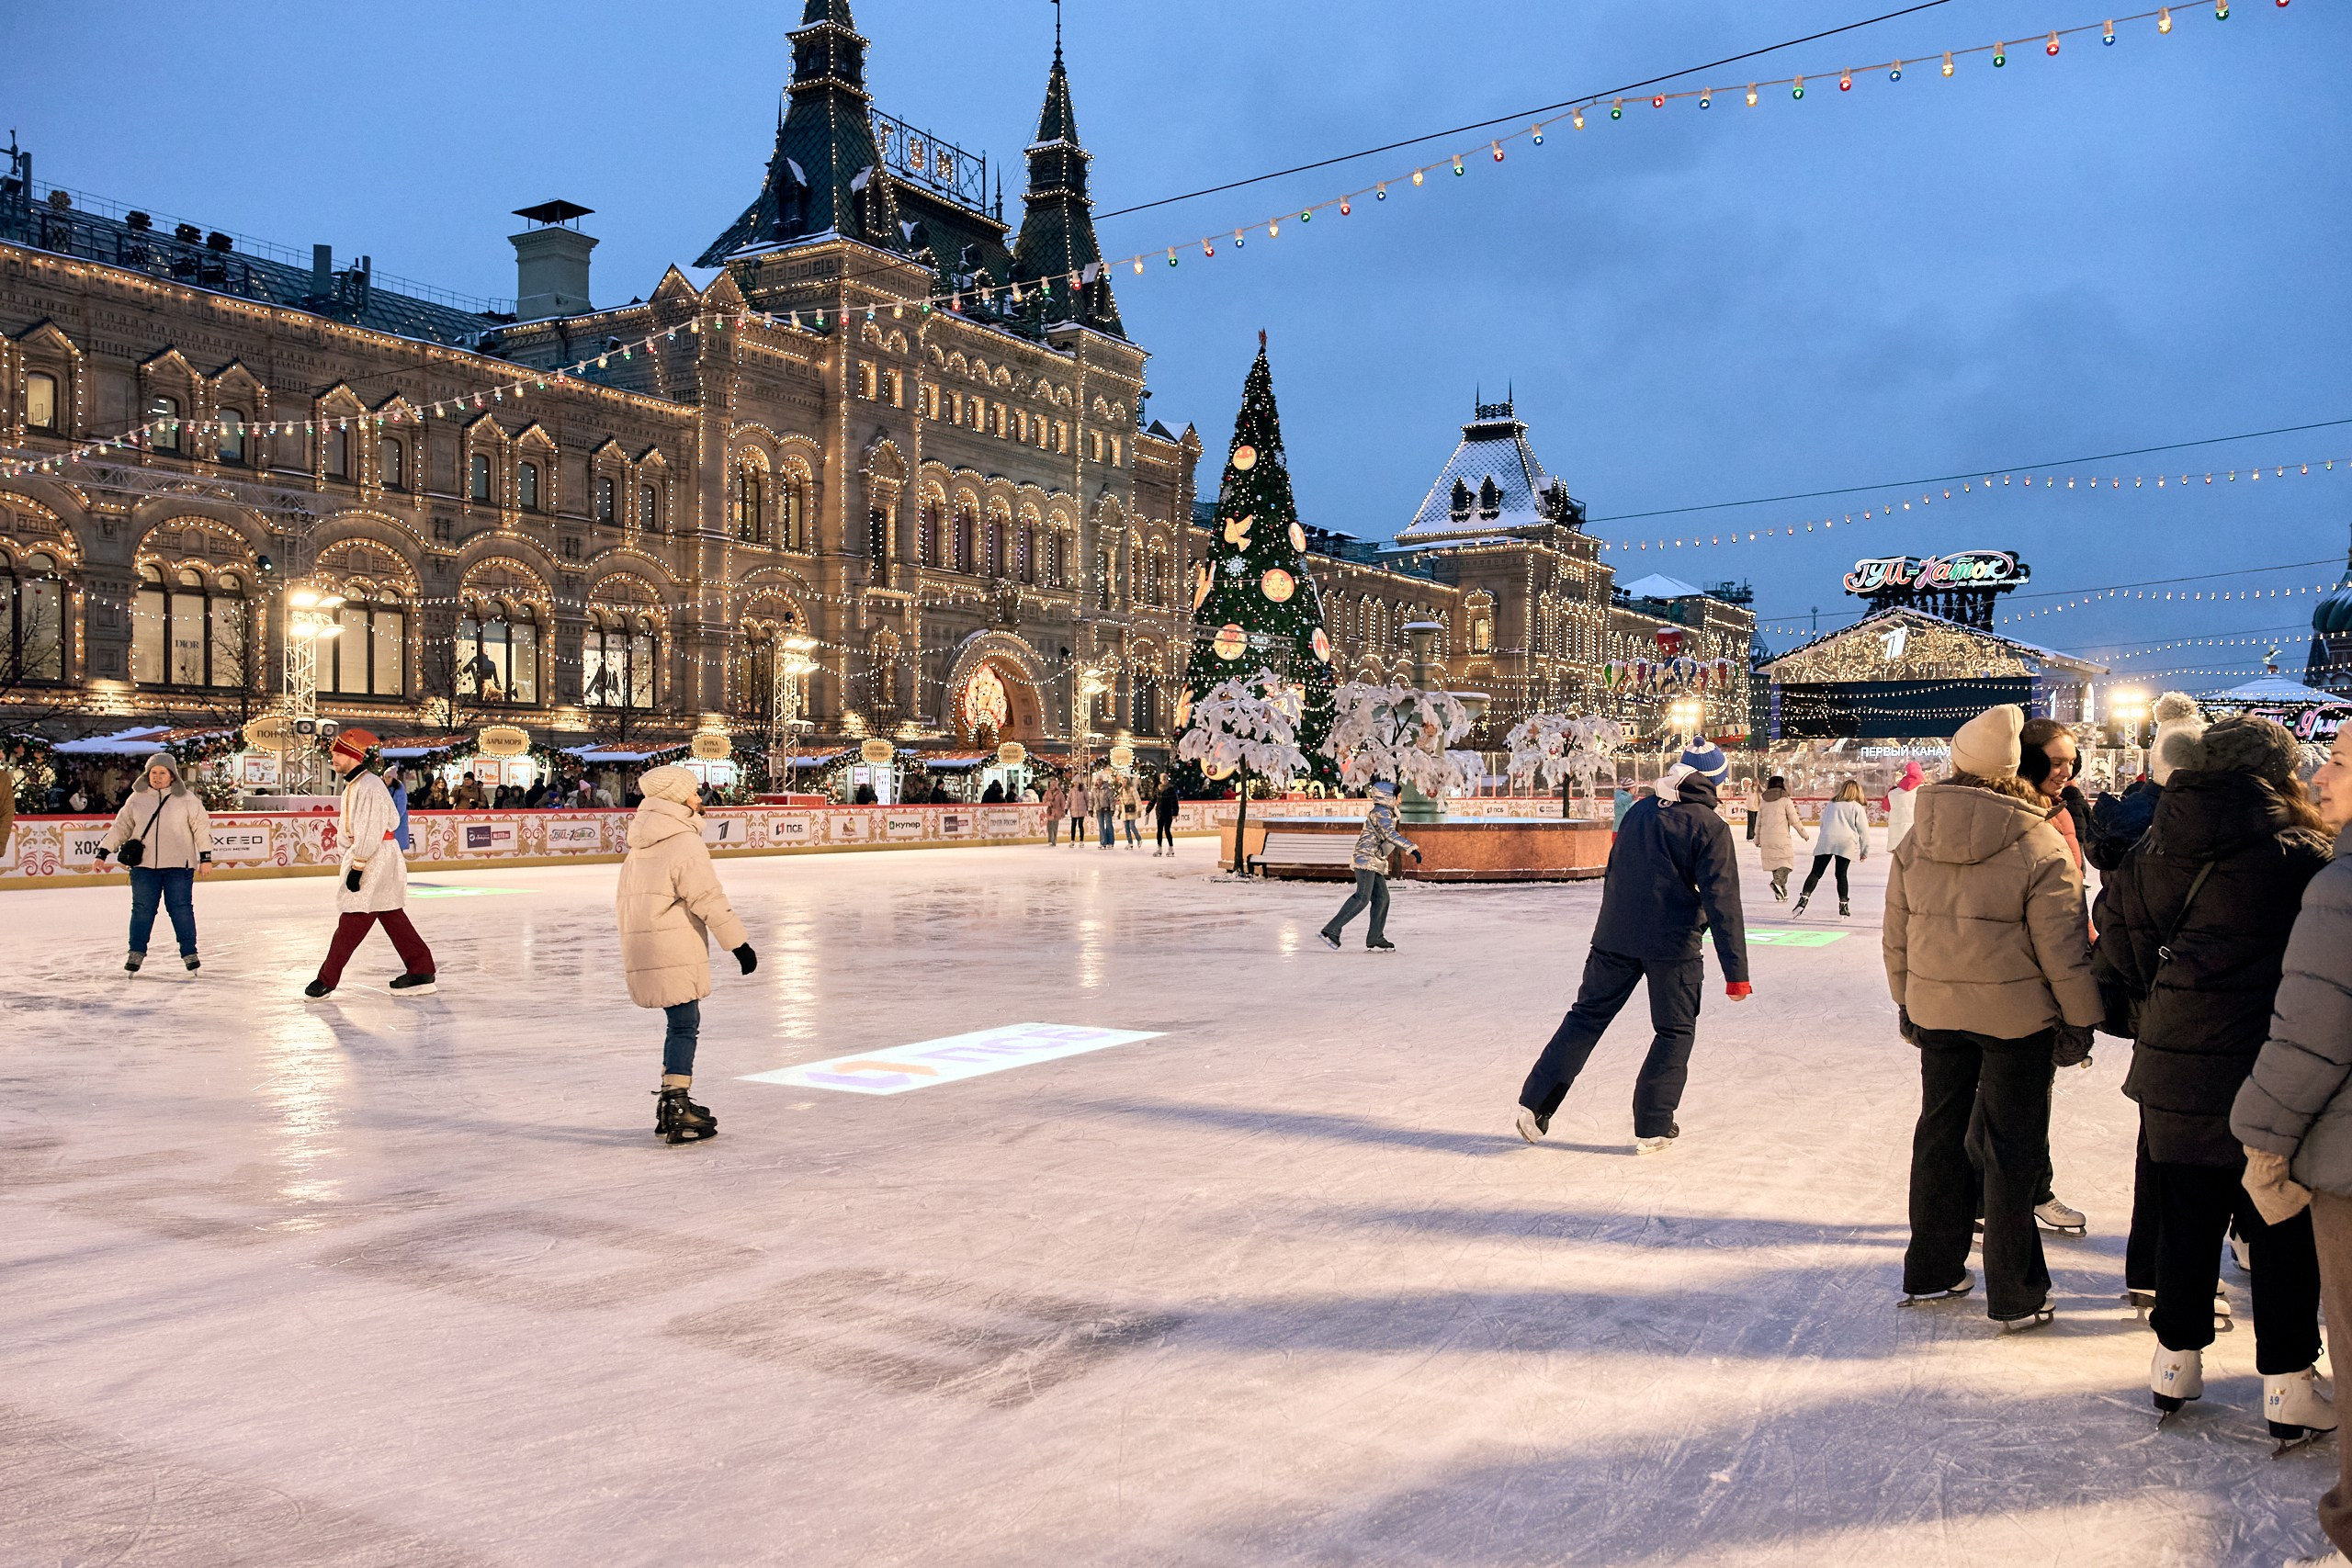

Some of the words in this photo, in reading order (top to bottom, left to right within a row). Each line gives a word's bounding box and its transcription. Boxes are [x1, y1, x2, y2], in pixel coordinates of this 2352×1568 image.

[175, 639, 199, 649] DIOR
[1860, 745, 1909, 757] ПЕРВЫЙ
[1911, 746, 1951, 757] КАНАЛ
[786, 824, 803, 833] ПСБ
[895, 821, 921, 829] купер
[213, 835, 263, 845] XEED
[2164, 1371, 2175, 1381] 39
[2269, 1395, 2279, 1405] 39
